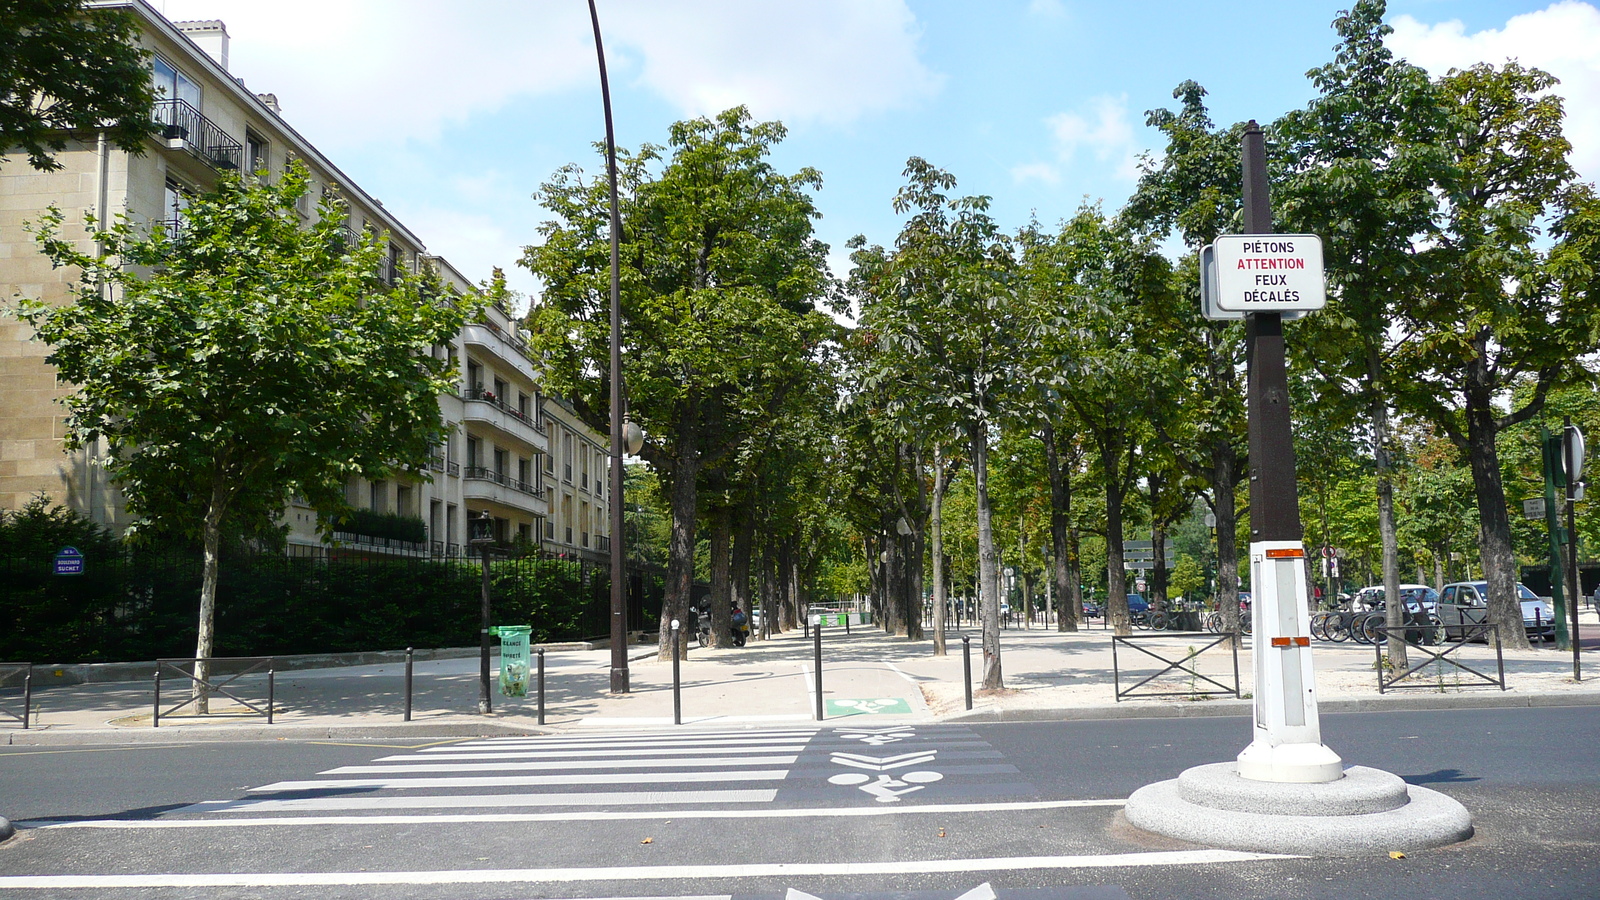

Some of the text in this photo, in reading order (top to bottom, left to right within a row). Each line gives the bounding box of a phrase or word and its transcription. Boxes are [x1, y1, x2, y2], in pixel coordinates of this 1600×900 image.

[1243, 240, 1295, 253] PIÉTONS
[1237, 258, 1305, 270] ATTENTION
[1255, 274, 1287, 286] FEUX
[1244, 289, 1300, 302] DÉCALÉS
